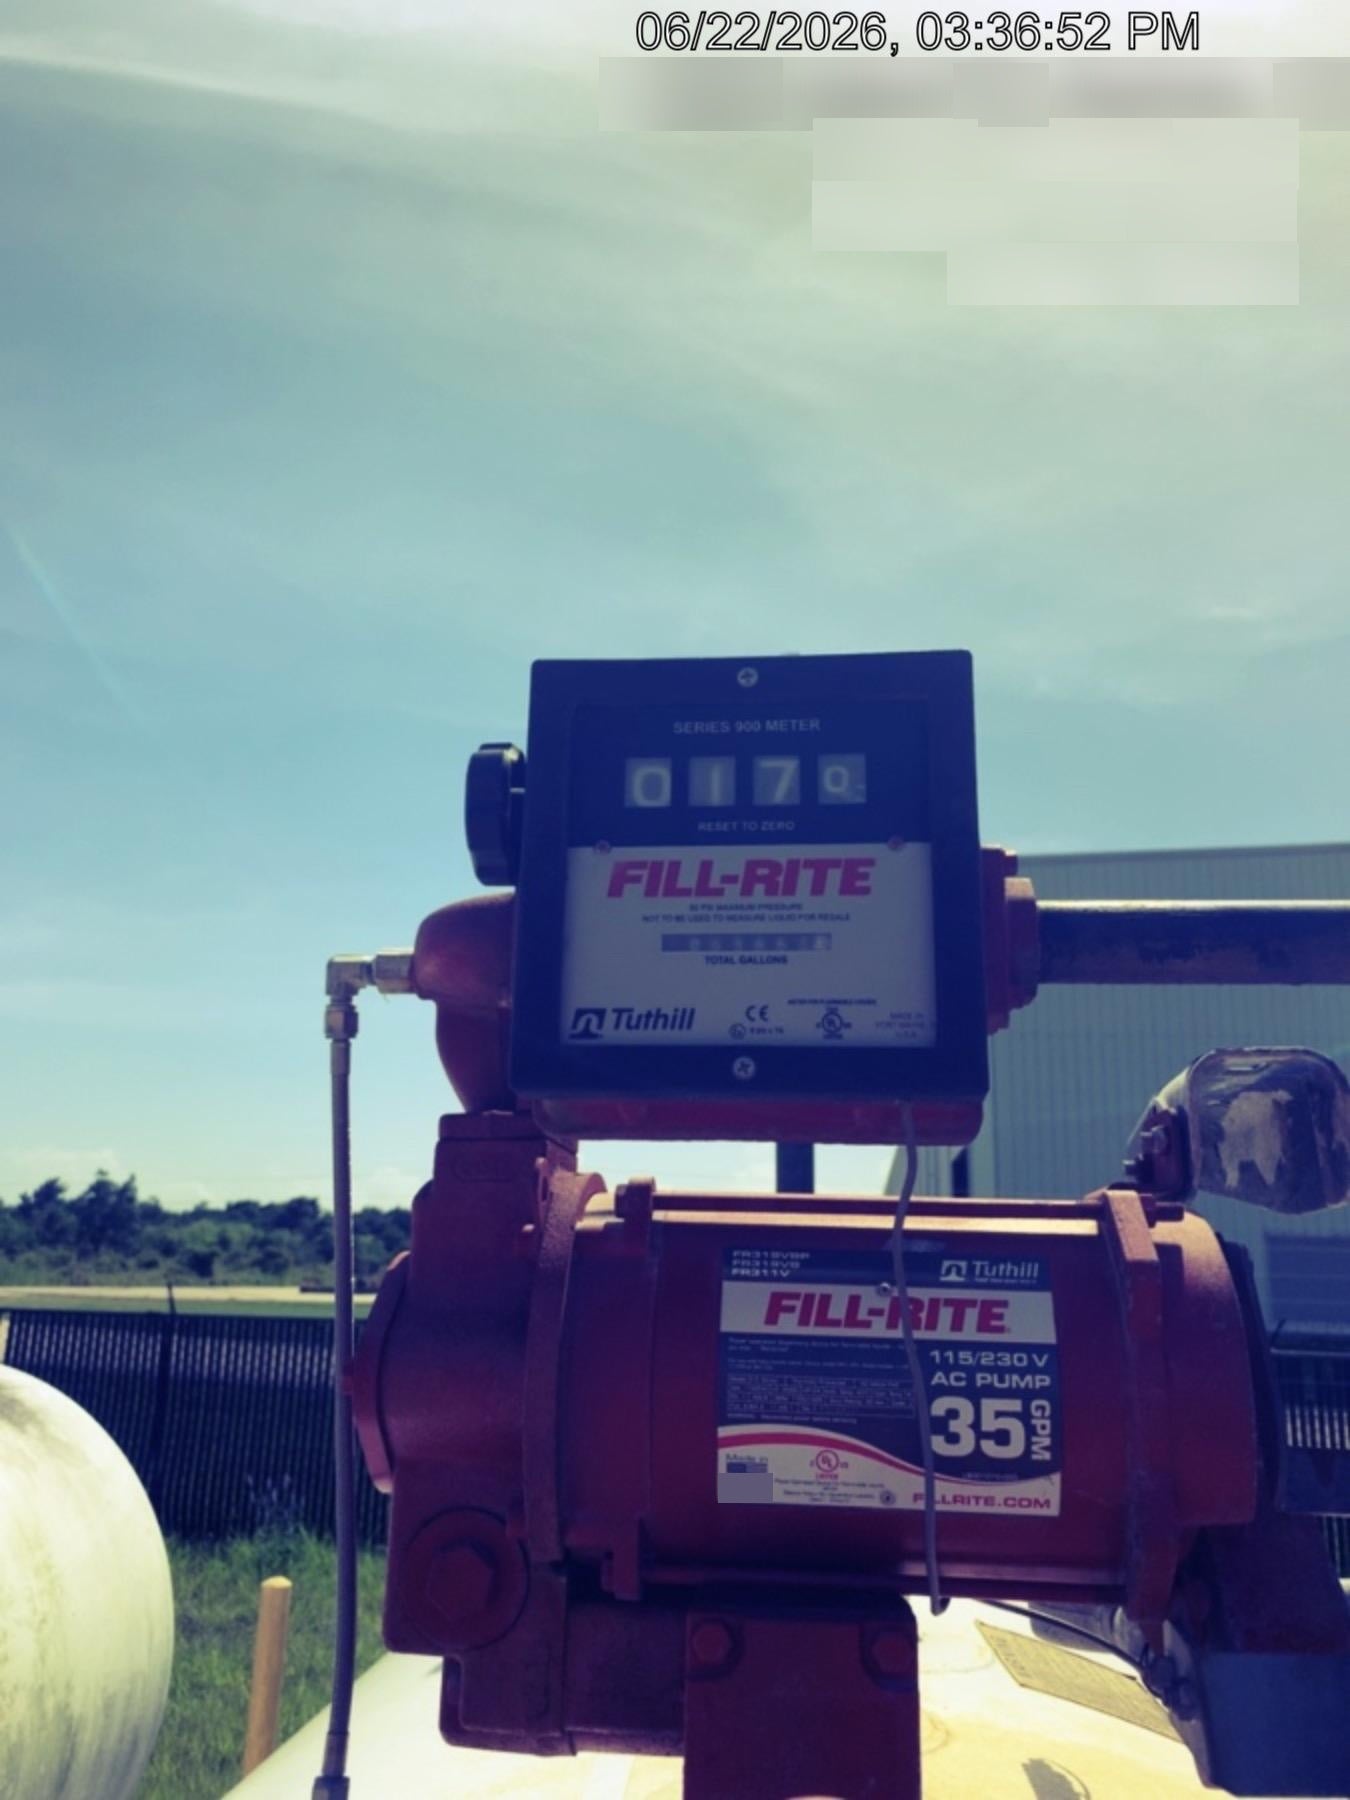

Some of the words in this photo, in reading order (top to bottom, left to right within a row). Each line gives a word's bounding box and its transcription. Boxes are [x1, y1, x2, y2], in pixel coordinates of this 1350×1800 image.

[673, 720, 731, 735] SERIES
[735, 719, 761, 733] 900
[765, 718, 821, 733] METER
[697, 821, 738, 832] RESET
[740, 821, 759, 832] TO
[761, 820, 796, 831] ZERO
[607, 857, 876, 898] FILL-RITE
[705, 955, 736, 965] TOTAL
[738, 954, 789, 965] GALLONS
[611, 1007, 696, 1031] Tuthill
[745, 1004, 769, 1022] CE
[972, 1260, 1039, 1278] Tuthill
[764, 1290, 1009, 1334] FILL-RITE
[929, 1349, 1029, 1368] 115/230
[1031, 1353, 1049, 1368] V
[930, 1371, 968, 1388] AC
[975, 1372, 1052, 1390] PUMP
[929, 1395, 1027, 1460] 35
[1029, 1398, 1052, 1462] GPM
[913, 1492, 1052, 1510] FLRITE.COM
